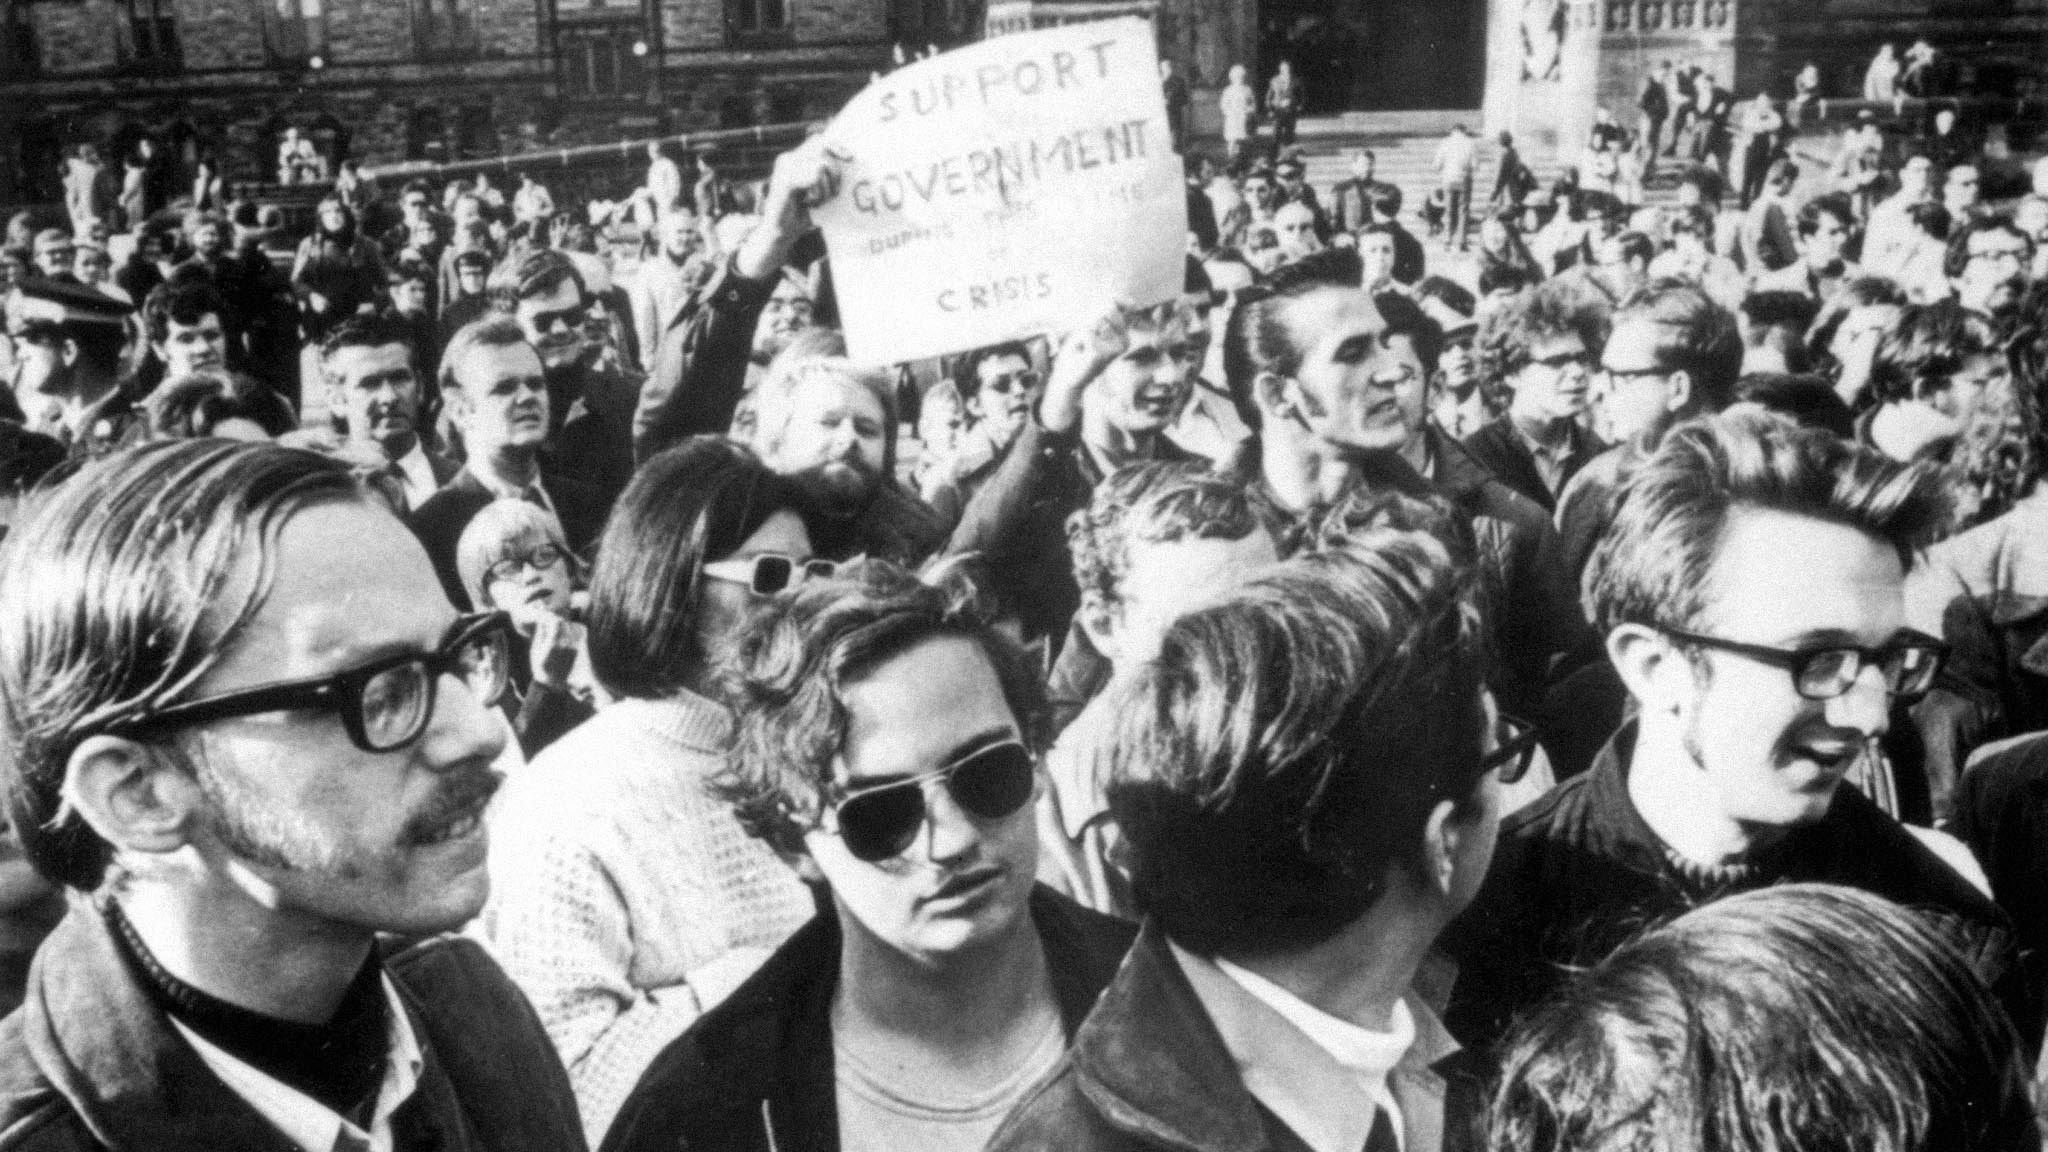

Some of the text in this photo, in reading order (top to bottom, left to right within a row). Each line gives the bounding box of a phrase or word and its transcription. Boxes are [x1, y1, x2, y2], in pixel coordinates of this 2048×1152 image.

[879, 39, 1117, 122] SUPPORT
[852, 118, 1150, 216] GOVERNMENT
[937, 273, 1052, 313] CRISIS
